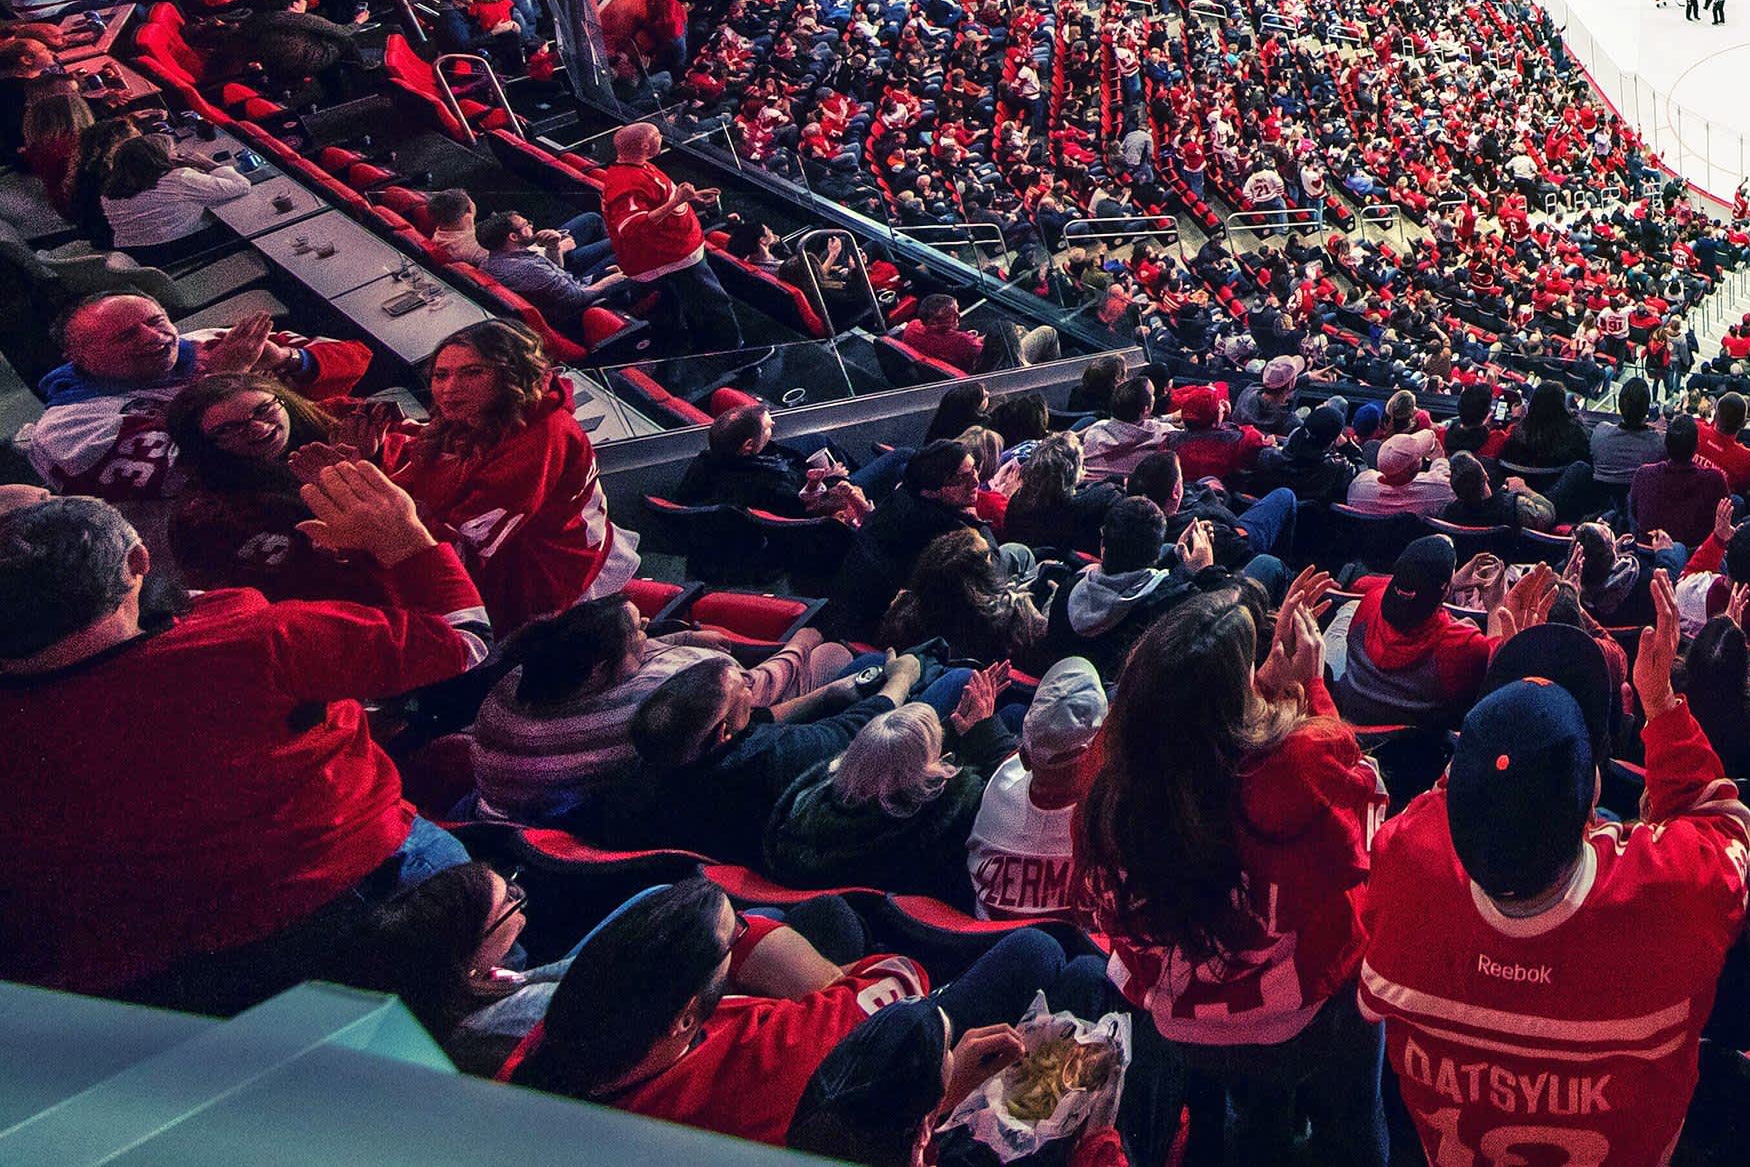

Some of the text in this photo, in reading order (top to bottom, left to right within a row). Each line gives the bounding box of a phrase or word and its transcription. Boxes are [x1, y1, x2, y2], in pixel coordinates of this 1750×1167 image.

[1607, 320, 1623, 333] 91
[1477, 953, 1554, 986] Reebok
[1403, 1034, 1613, 1115] DATSYUK
